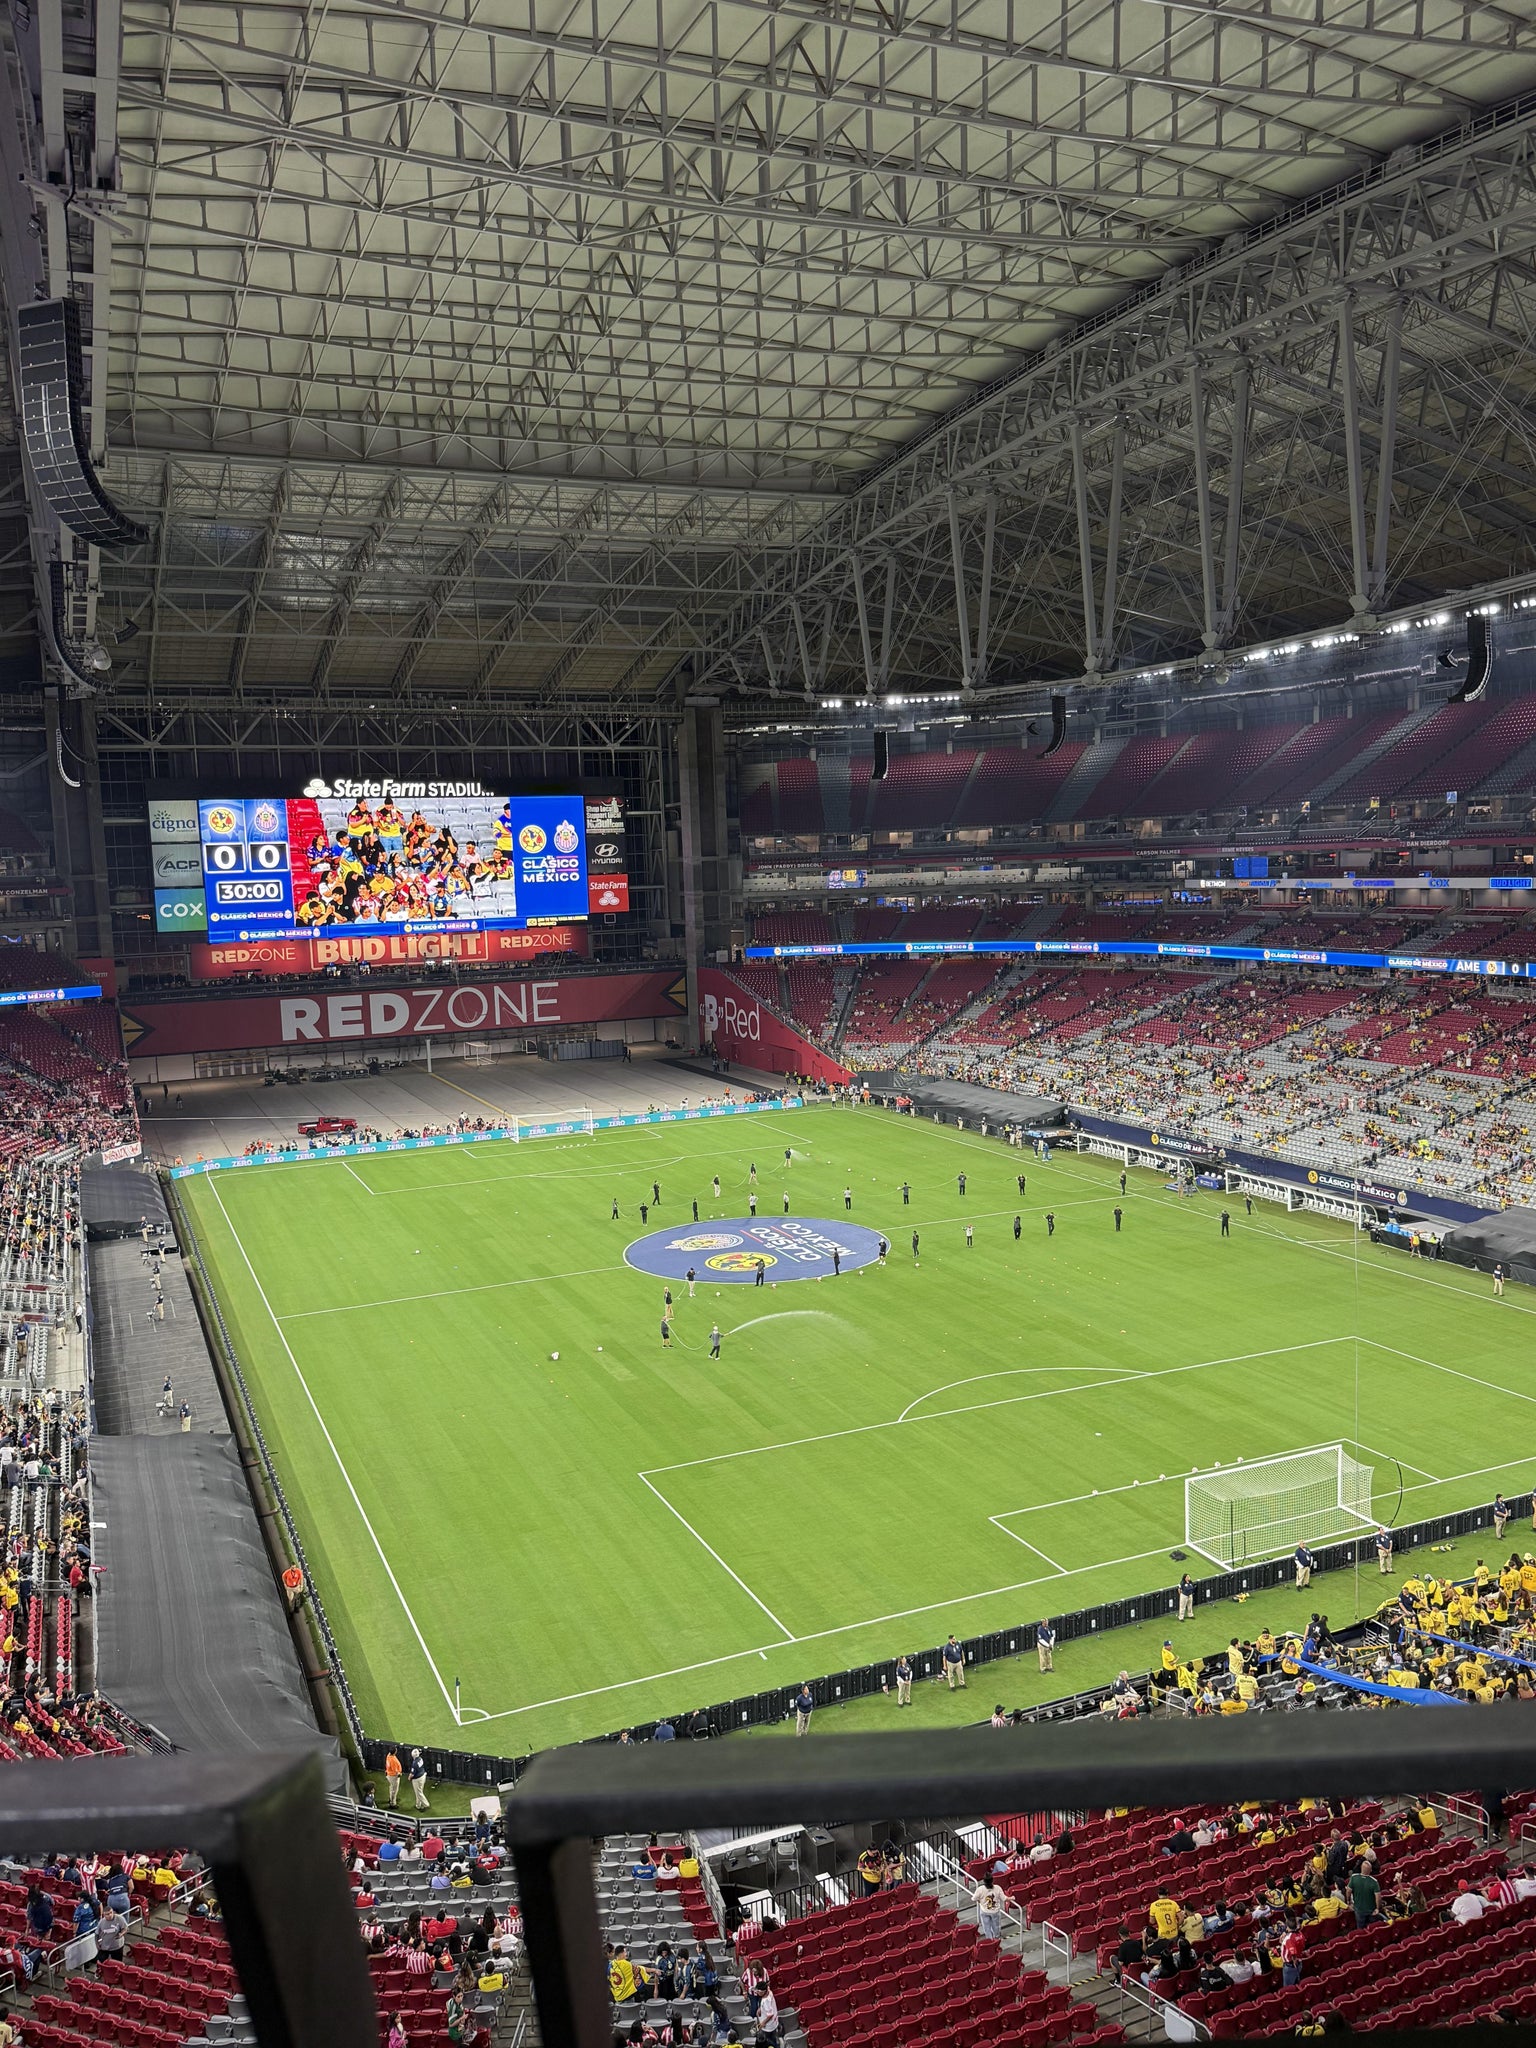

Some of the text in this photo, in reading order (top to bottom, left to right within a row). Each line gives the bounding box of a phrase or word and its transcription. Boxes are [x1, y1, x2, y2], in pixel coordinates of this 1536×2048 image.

[152, 816, 196, 832] cigna
[214, 846, 236, 870] 0
[258, 845, 280, 869] 0
[163, 860, 200, 870] ACP
[523, 871, 580, 883] MÉXICO
[1429, 879, 1450, 887] COX
[1491, 879, 1531, 887] BUD LIGHT
[221, 883, 279, 899] 30:00
[160, 903, 203, 918] COX
[317, 933, 480, 963] BUD LIGHT
[1456, 961, 1480, 971] AME
[1511, 963, 1519, 974] 0
[529, 1127, 546, 1135] ZERO
[556, 1125, 573, 1133] ZERO
[445, 1136, 464, 1144] ZERO
[473, 1133, 492, 1141] ZERO
[386, 1143, 406, 1151] ZERO
[416, 1139, 435, 1148] ZERO
[326, 1149, 346, 1157] ZERO
[356, 1146, 376, 1154] ZERO
[264, 1155, 284, 1164] ZERO
[295, 1152, 315, 1160] ZERO
[232, 1159, 252, 1167] ZERO
[1319, 1176, 1396, 1200] CLÁSICO DE MÉXICO
[1164, 1913, 1172, 1925] 8
